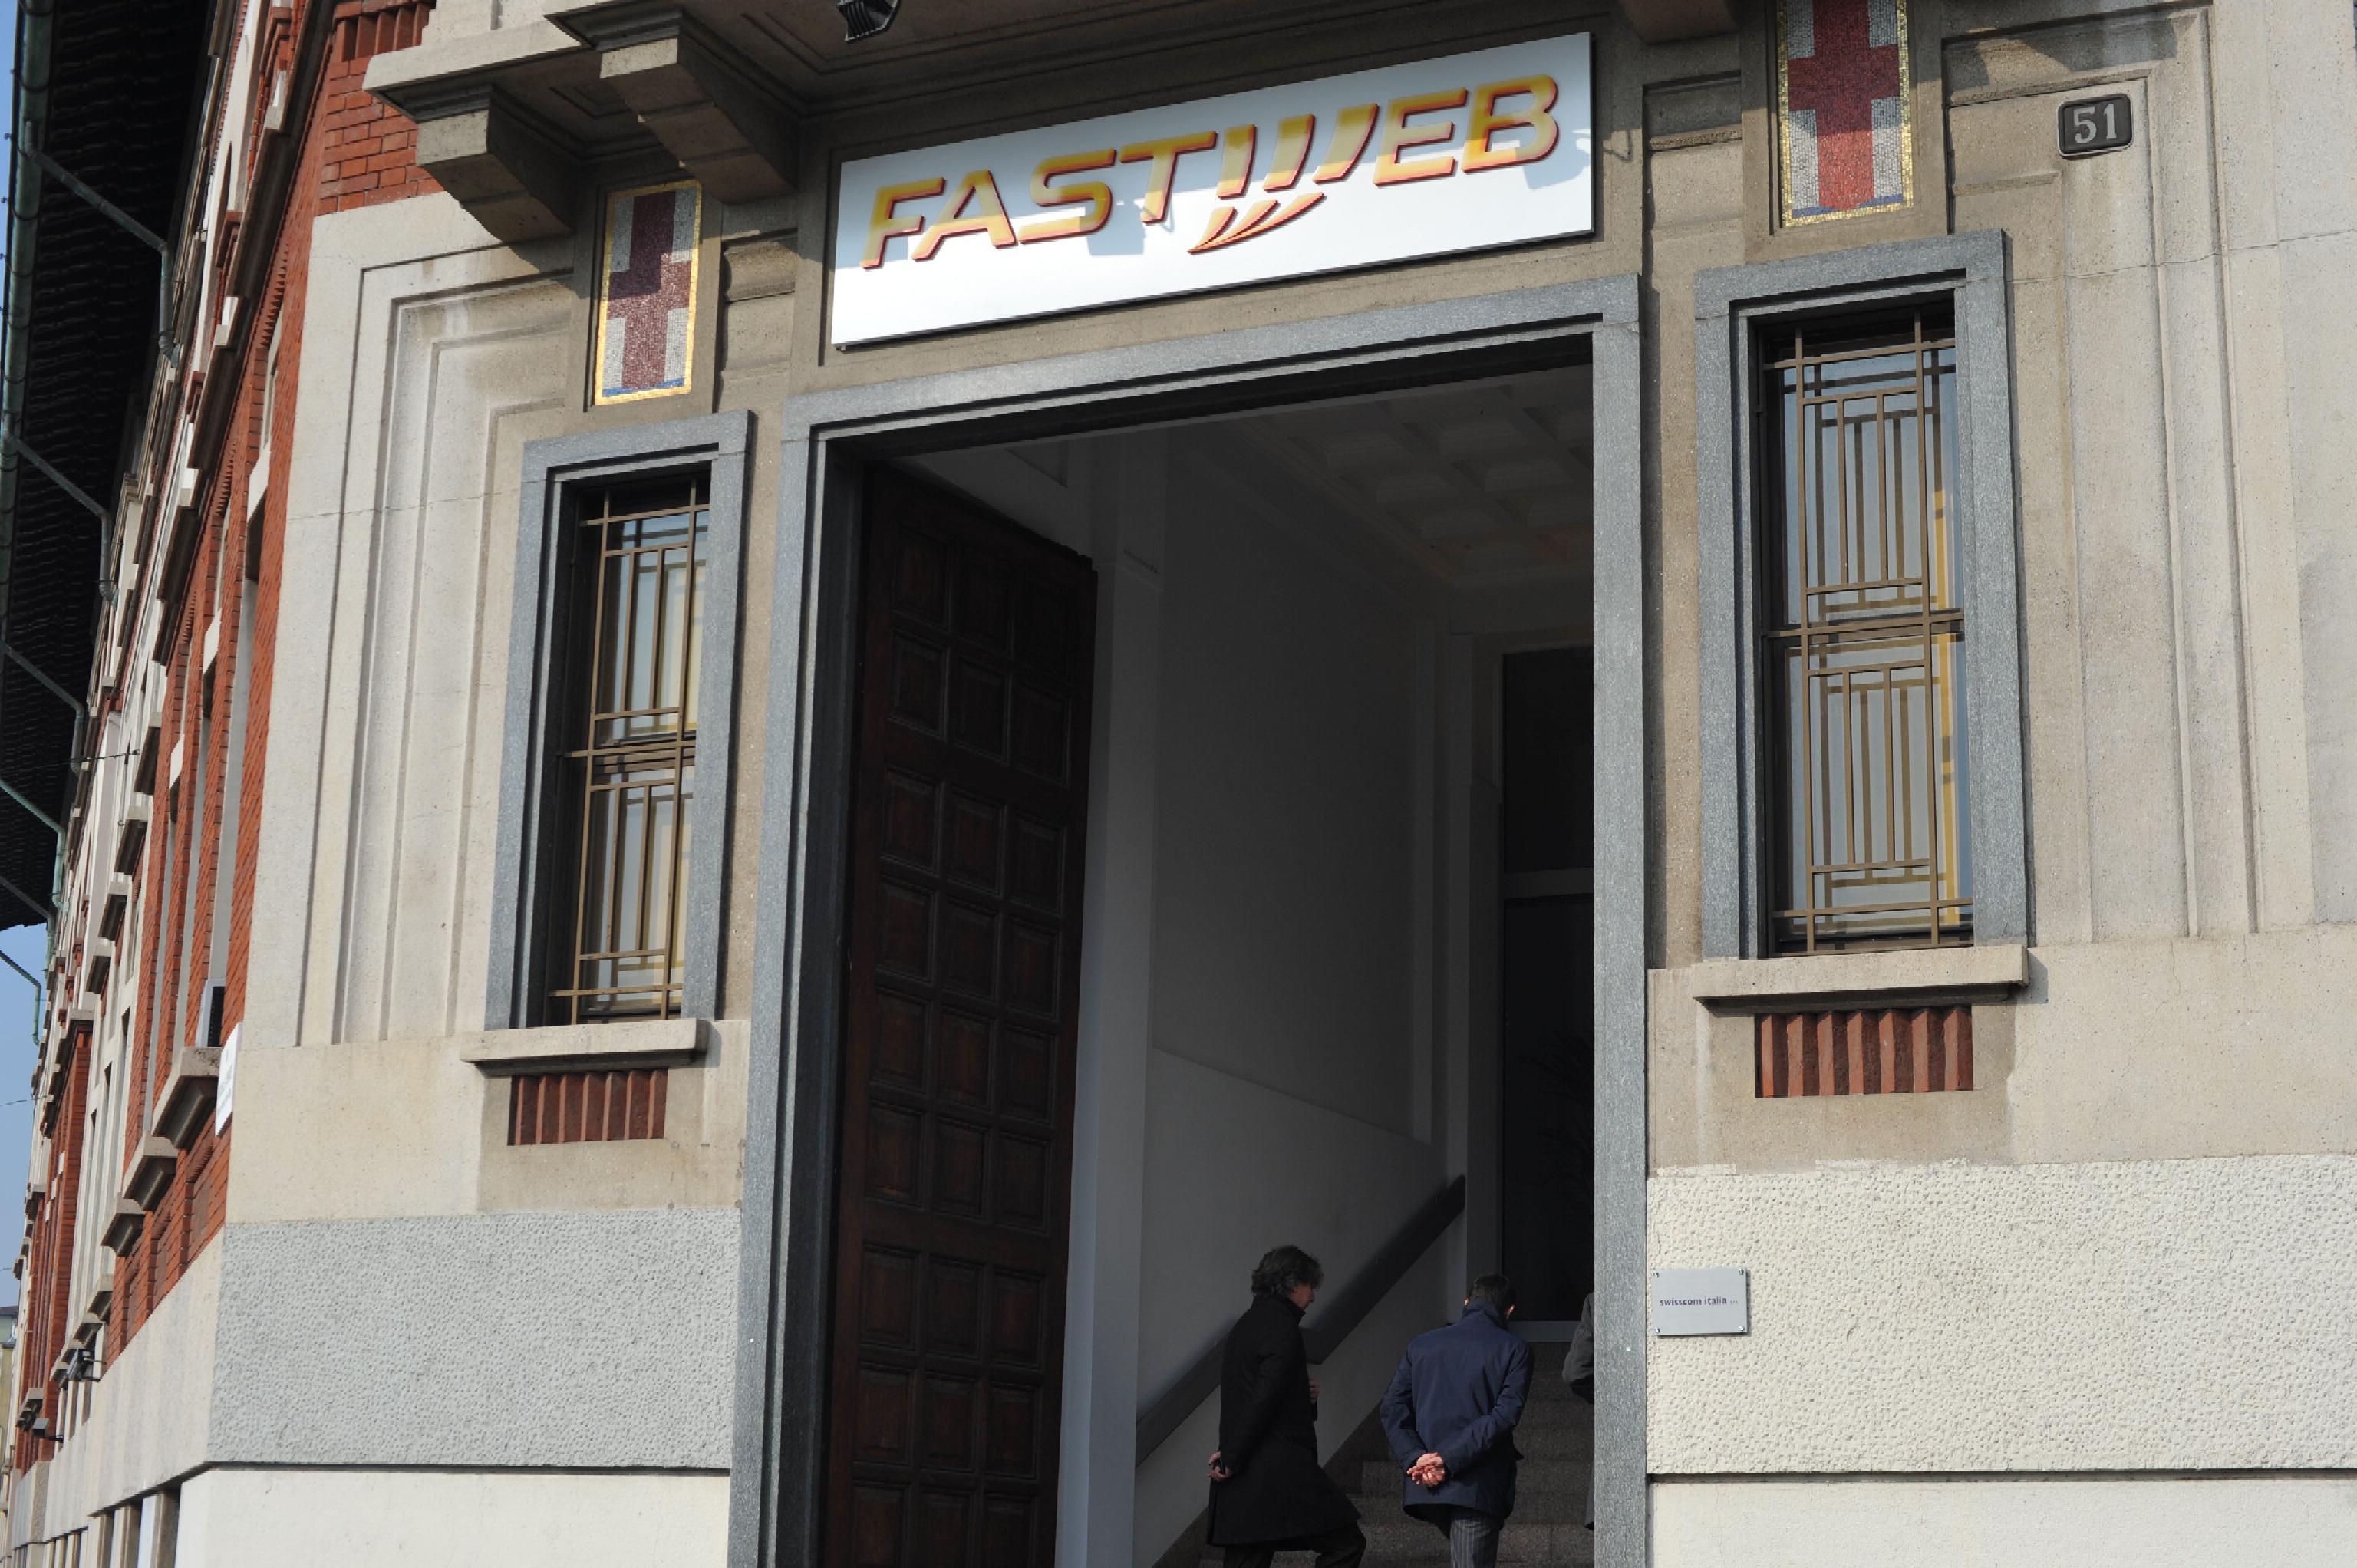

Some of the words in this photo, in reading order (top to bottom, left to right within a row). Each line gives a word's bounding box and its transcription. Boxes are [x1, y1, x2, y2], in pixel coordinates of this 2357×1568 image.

[2073, 103, 2118, 143] 51
[861, 73, 1559, 270] FASTWEB
[1660, 1297, 1702, 1306] swisscom
[1704, 1296, 1727, 1305] italia
